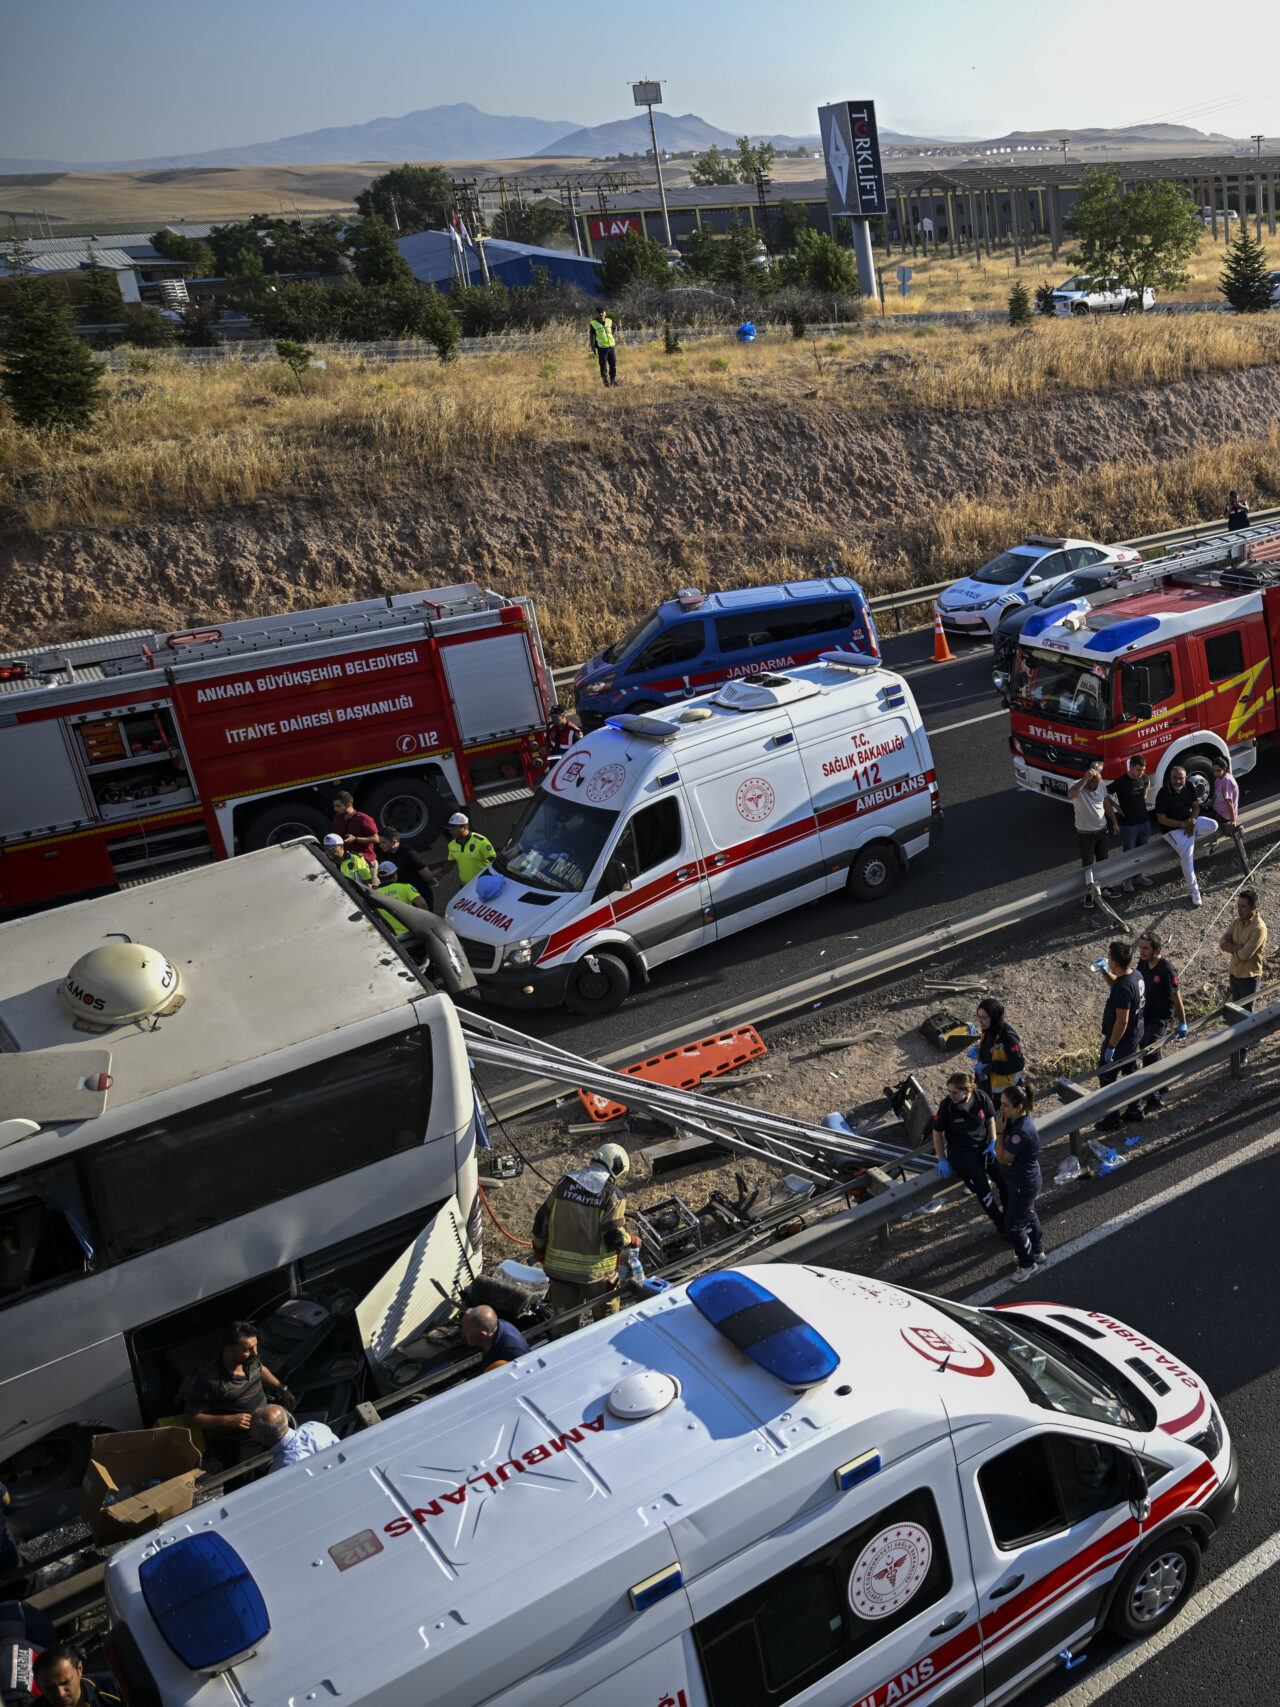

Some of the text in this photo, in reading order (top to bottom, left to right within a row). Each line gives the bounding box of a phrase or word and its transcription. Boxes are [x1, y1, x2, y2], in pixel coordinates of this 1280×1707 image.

[197, 648, 419, 704] ANKARA BÜYÜKŞEHİR BELEDİYESİ
[726, 654, 796, 680] JANDARMA
[225, 695, 414, 745] İTFAİYE DAİRESİ BAŞKANLIĞI
[1137, 720, 1169, 738] İTFAİYE
[418, 731, 440, 748] 112
[851, 732, 870, 750] T.C.
[822, 734, 905, 778] SAĞLIK BAKANLIĞI
[852, 762, 883, 791] 112
[856, 774, 926, 812] AMBULANS
[383, 1413, 605, 1538] AMBULANS
[343, 1542, 378, 1566] 112
